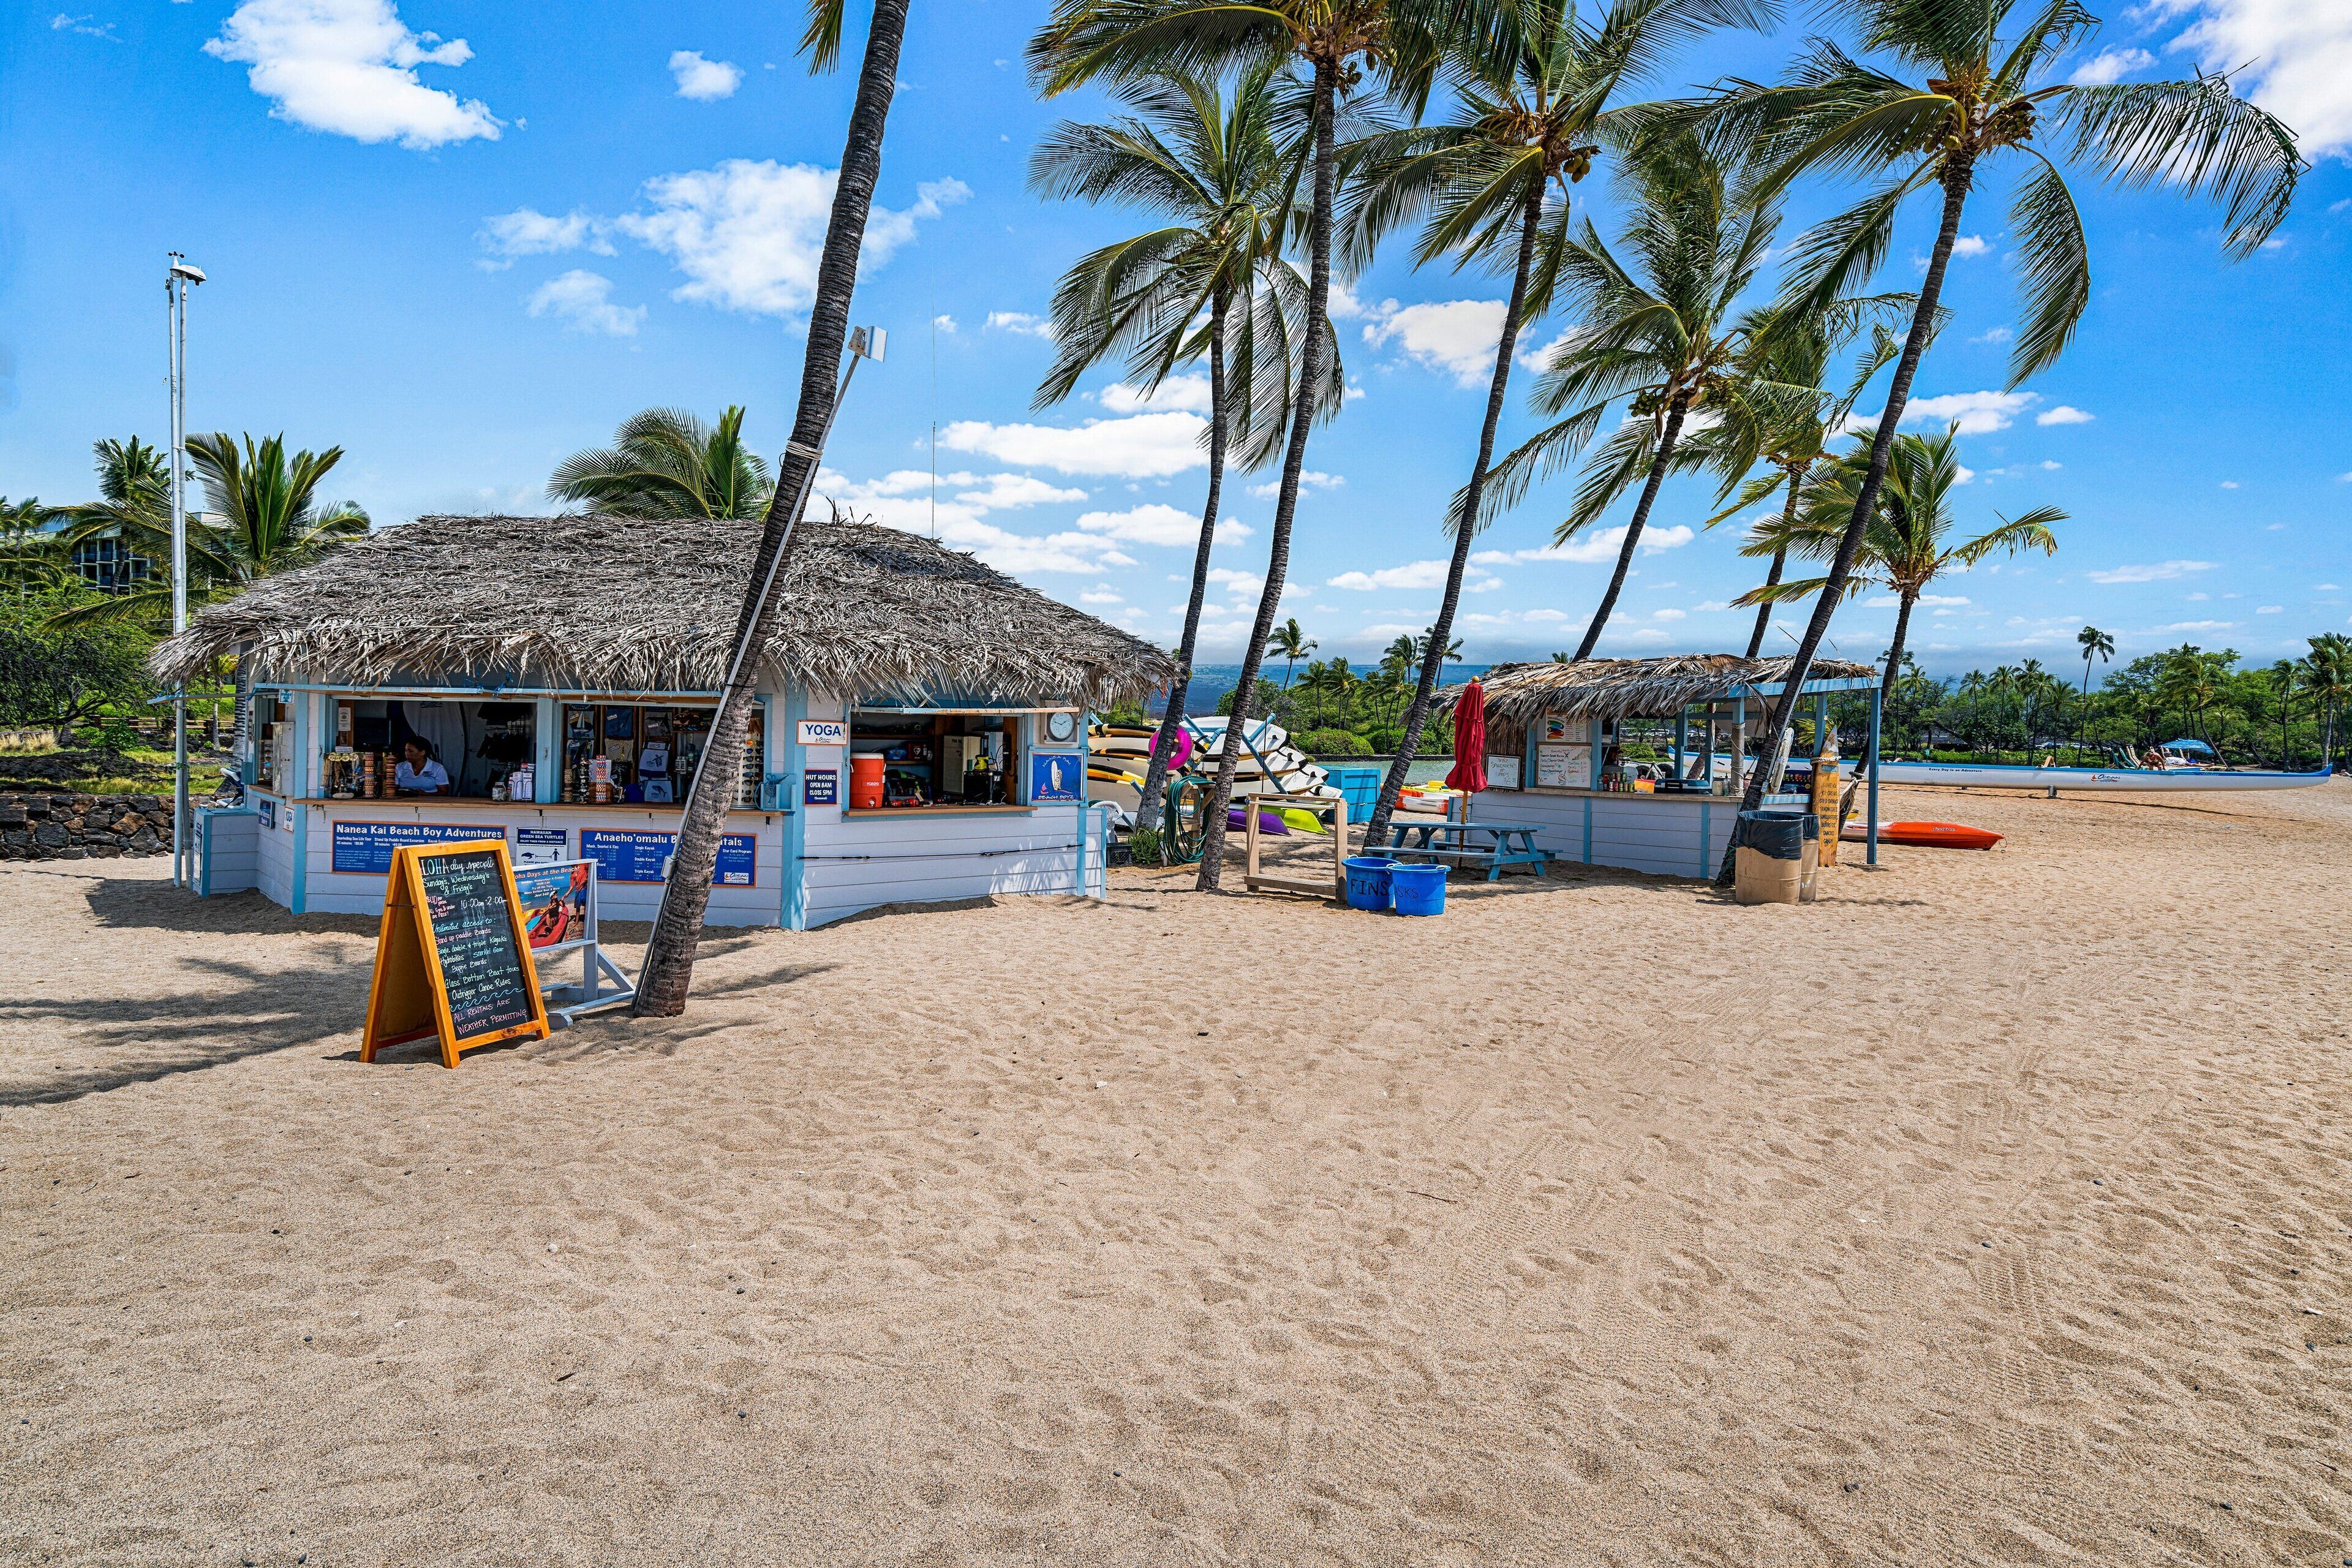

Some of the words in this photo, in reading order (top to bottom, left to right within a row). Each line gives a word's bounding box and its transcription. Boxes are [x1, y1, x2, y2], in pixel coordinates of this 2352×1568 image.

[805, 724, 841, 736] YOGA
[337, 824, 368, 834] Nanea
[371, 826, 386, 834] Kai
[390, 826, 420, 835] Beach
[423, 827, 442, 837] Boy
[445, 828, 502, 838] Adventures
[595, 832, 667, 843] Anaeho'omalu
[451, 859, 465, 873] day
[466, 857, 494, 872] special
[451, 873, 490, 884] Wednesday's
[444, 886, 449, 895] &
[453, 883, 473, 894] Friday's
[1351, 878, 1389, 895] FINS
[1394, 885, 1419, 898] SKS
[426, 895, 437, 905] $40
[432, 922, 459, 933] Unlimited
[462, 919, 483, 928] access
[435, 936, 448, 945] Stand
[456, 931, 472, 941] paddle
[489, 935, 507, 946] Kayaks
[440, 954, 464, 967] Hydrobikes
[451, 963, 467, 973] Boogie
[470, 958, 488, 968] Boards
[445, 979, 460, 989] Glass
[463, 973, 485, 984] Bottom
[487, 967, 504, 977] Boat
[452, 988, 476, 1000] Outrigger
[478, 983, 494, 993] Canoe
[494, 978, 511, 987] Rides
[454, 1012, 466, 1023] ALL
[467, 1003, 493, 1018] RENTALS
[497, 998, 511, 1008] ARE
[457, 1019, 489, 1035] WEATHER
[490, 1009, 527, 1023] PERMITTING
